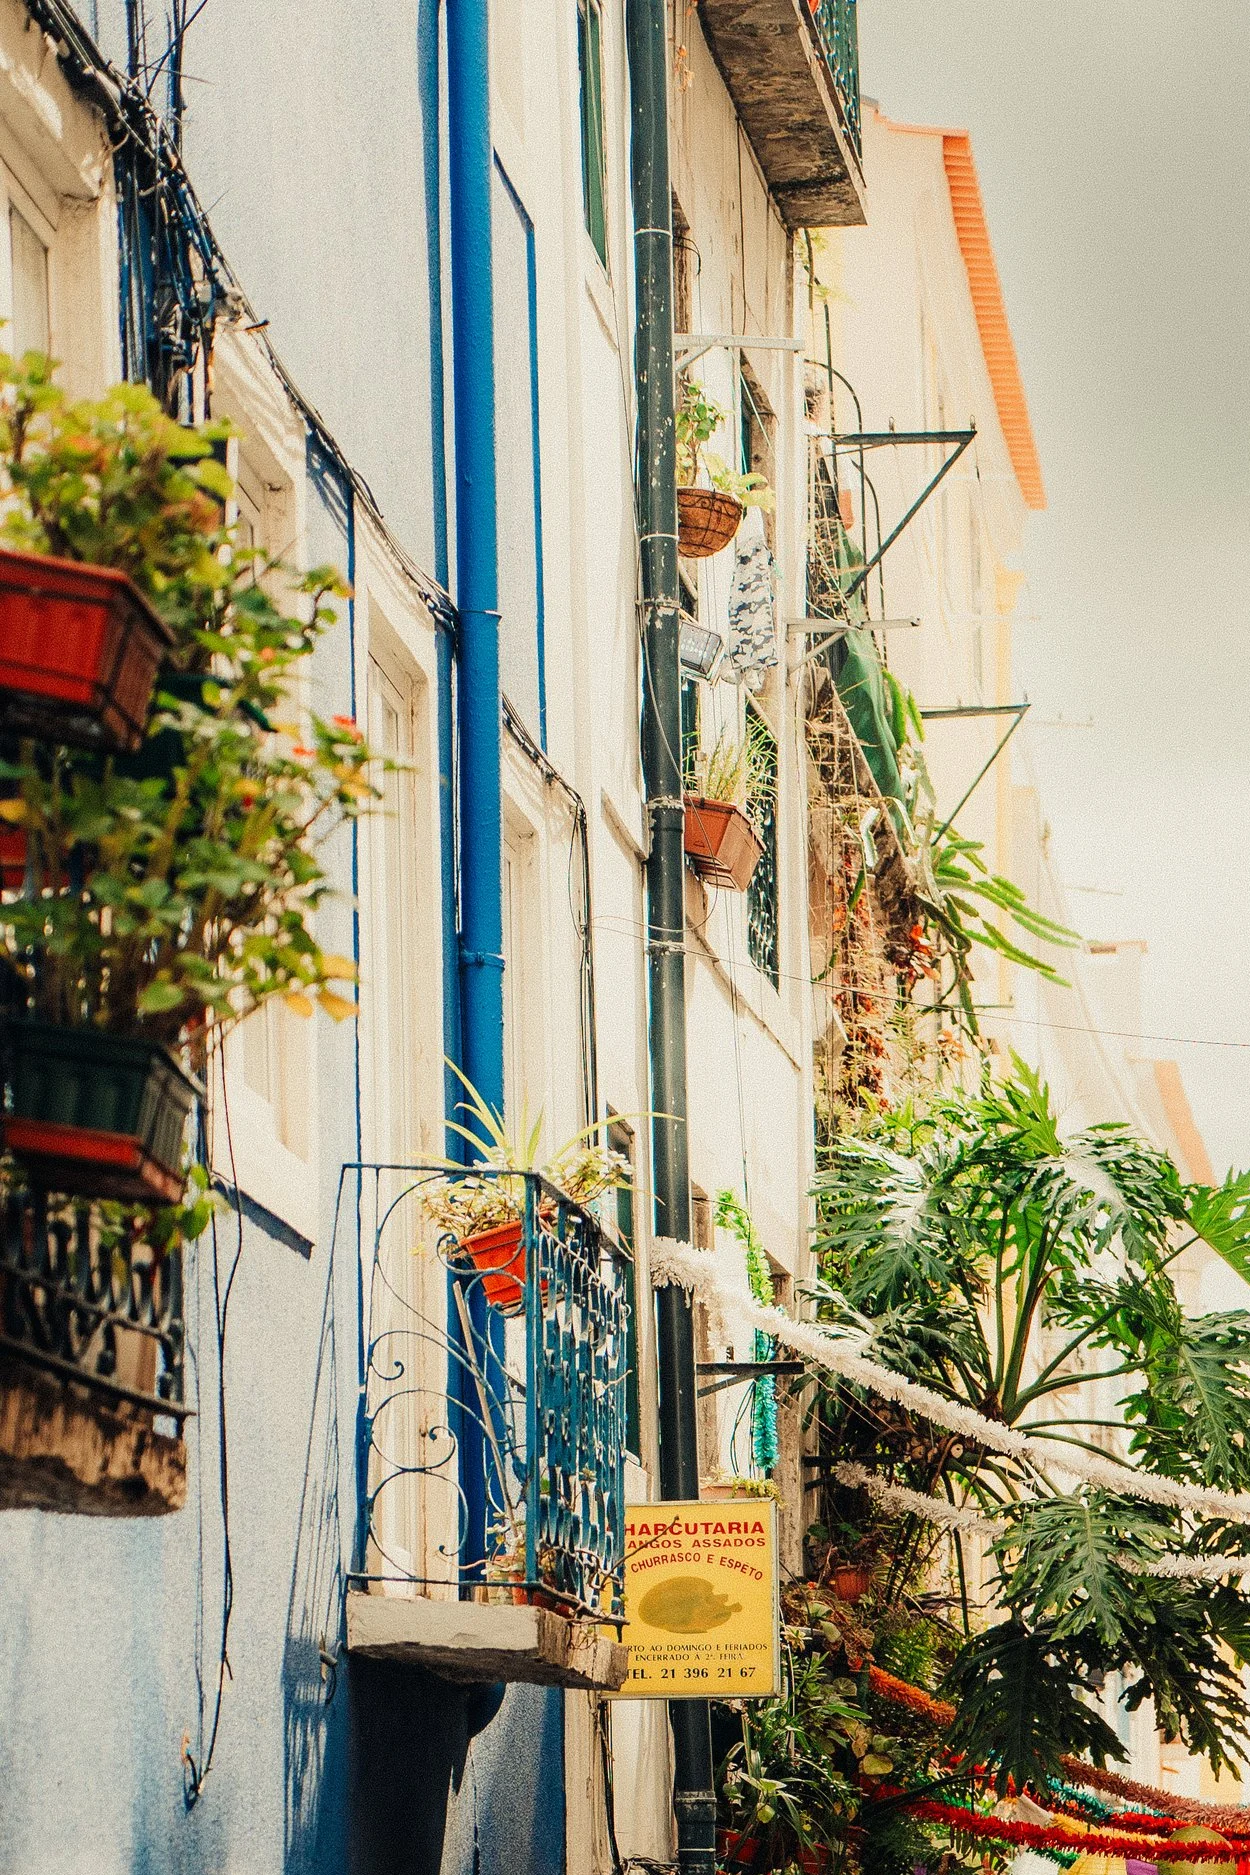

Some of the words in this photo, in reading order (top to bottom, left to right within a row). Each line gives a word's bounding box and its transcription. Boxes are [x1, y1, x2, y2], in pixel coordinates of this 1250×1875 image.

[624, 1521, 765, 1536] HARCUTARIA
[627, 1539, 682, 1549] ANGOS
[692, 1537, 766, 1548] ASSADOS
[630, 1552, 701, 1574] CHURRASCO
[707, 1554, 715, 1564] E
[719, 1556, 763, 1581] ESPETO
[650, 1644, 662, 1652] AO
[667, 1643, 712, 1652] DOMINGO
[716, 1643, 721, 1651] E
[725, 1643, 768, 1651] FERIADOS
[635, 1653, 690, 1662] ENCERRADO
[626, 1668, 652, 1680] TEL.
[660, 1668, 675, 1679] 21
[683, 1667, 709, 1679] 396
[717, 1667, 732, 1678] 21
[740, 1667, 756, 1678] 67
